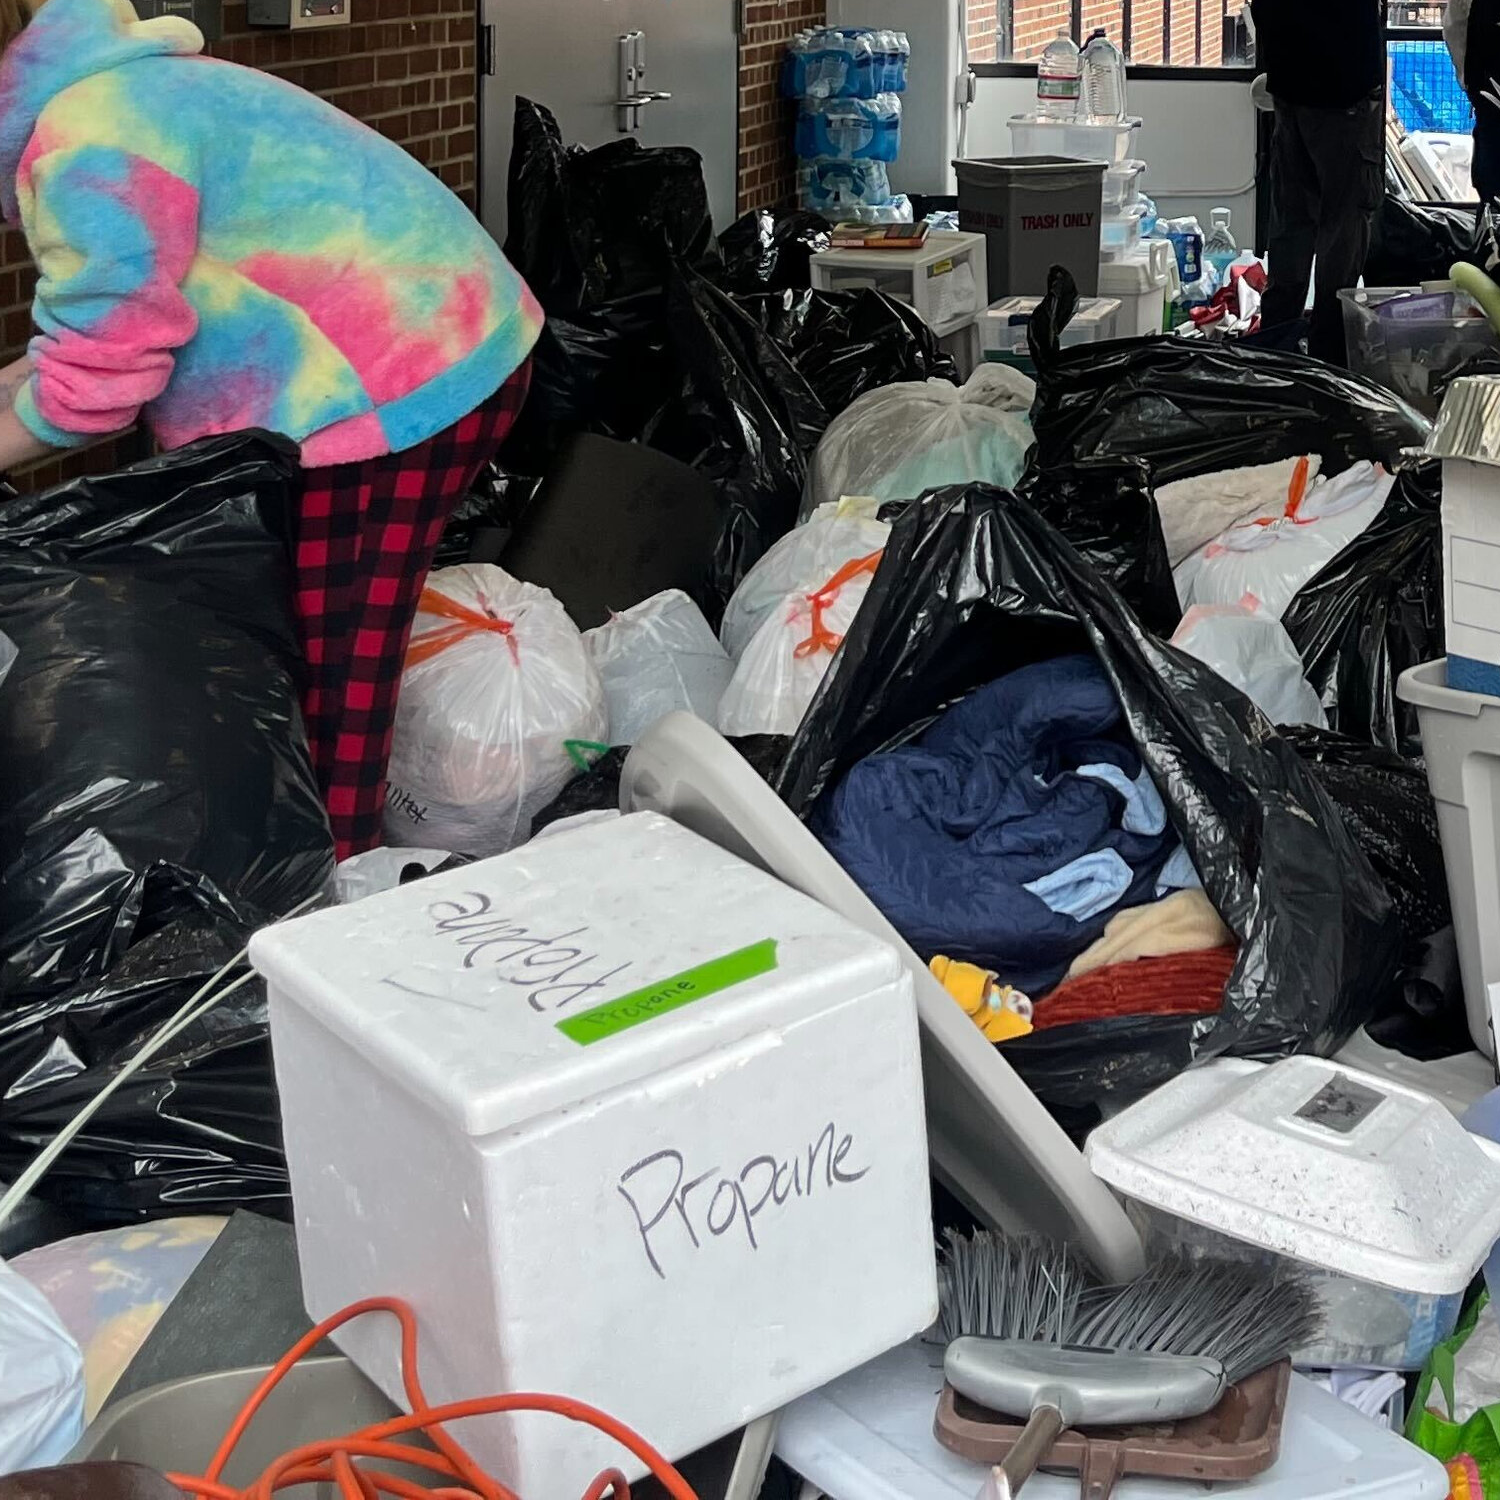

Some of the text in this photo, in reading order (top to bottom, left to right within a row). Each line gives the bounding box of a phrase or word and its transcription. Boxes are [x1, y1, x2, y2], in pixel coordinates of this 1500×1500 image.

[1020, 212, 1094, 231] TRASH ONLY
[579, 978, 698, 1030] Propane
[616, 1120, 873, 1280] Propane
